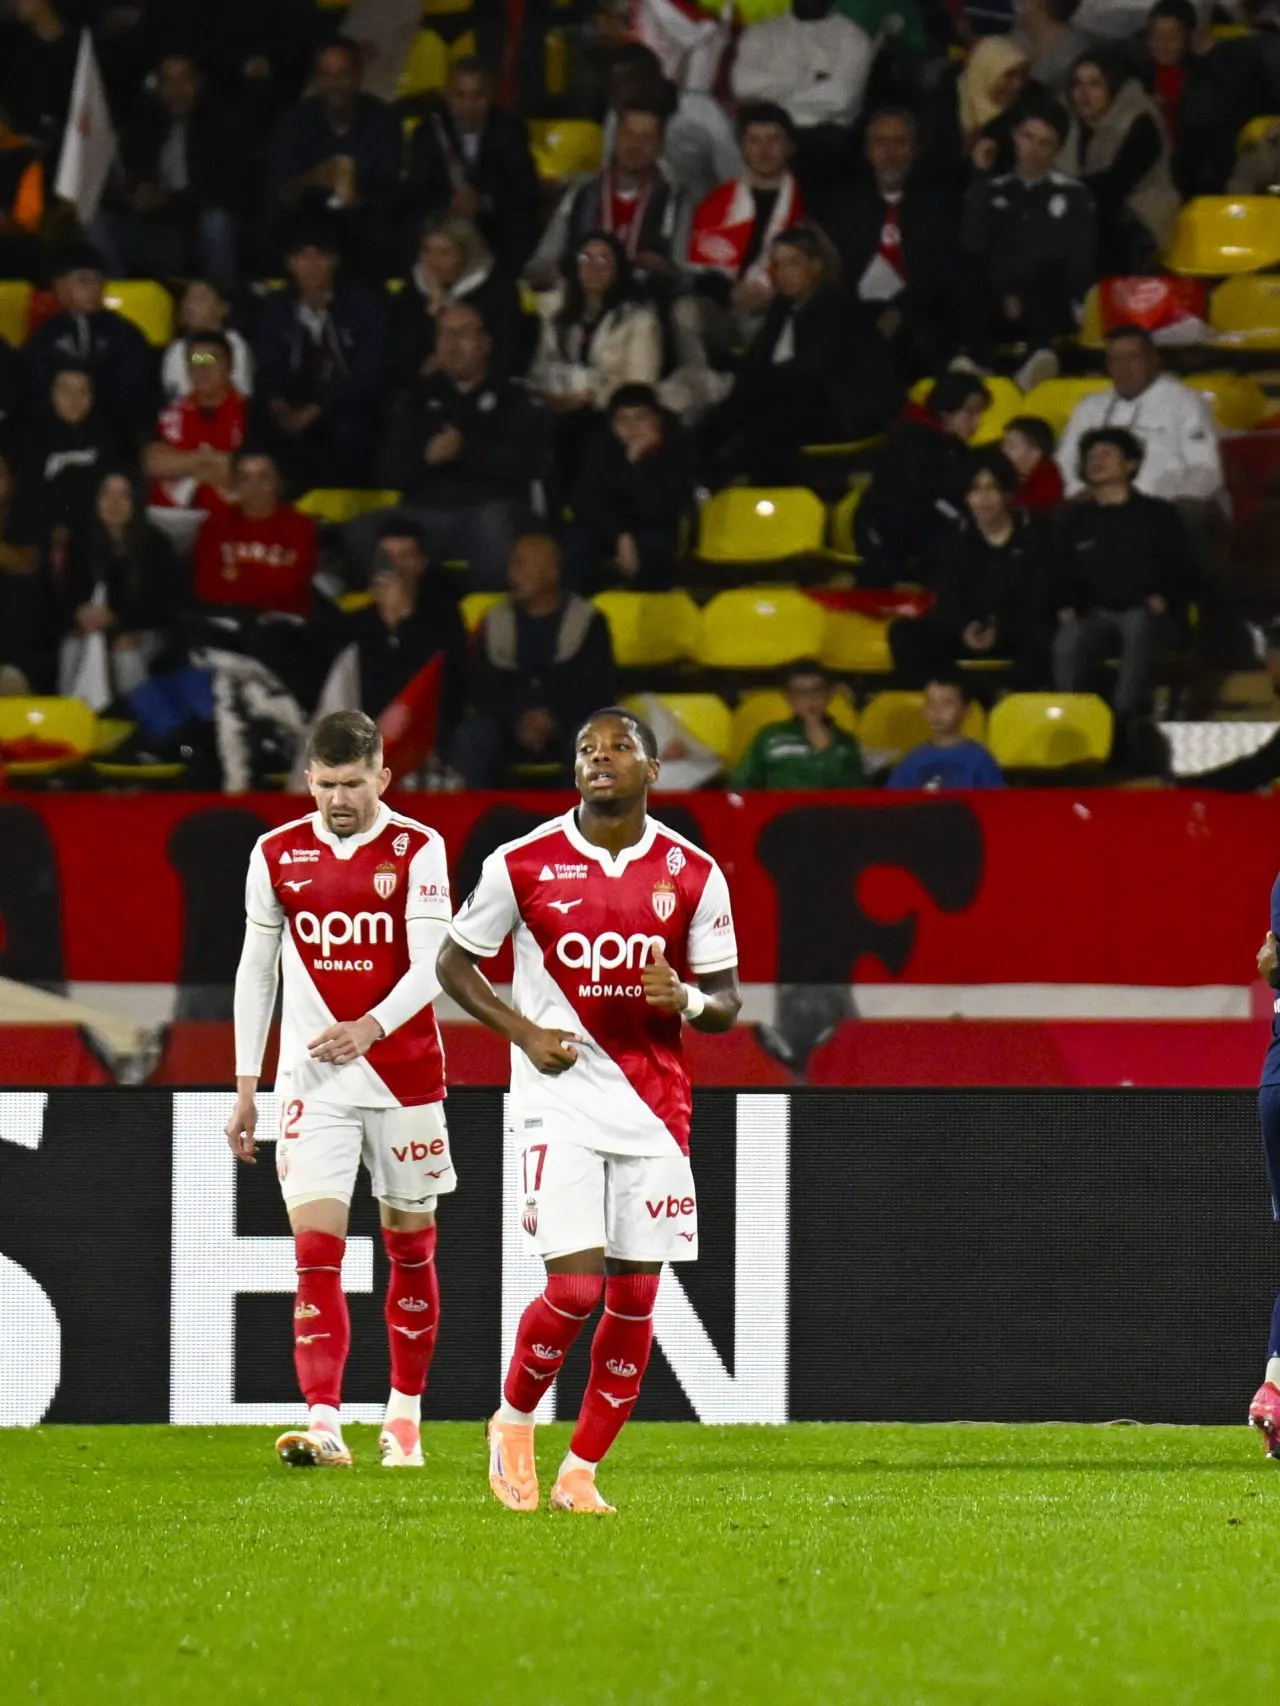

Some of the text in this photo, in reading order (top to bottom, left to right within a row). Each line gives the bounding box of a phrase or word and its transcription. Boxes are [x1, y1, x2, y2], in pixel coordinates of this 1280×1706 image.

[295, 911, 394, 957] apm
[556, 931, 667, 982] apm
[313, 959, 374, 971] MONACO
[578, 984, 643, 998] MONACO
[521, 1143, 548, 1195] 17
[0, 1092, 791, 1426] EN
